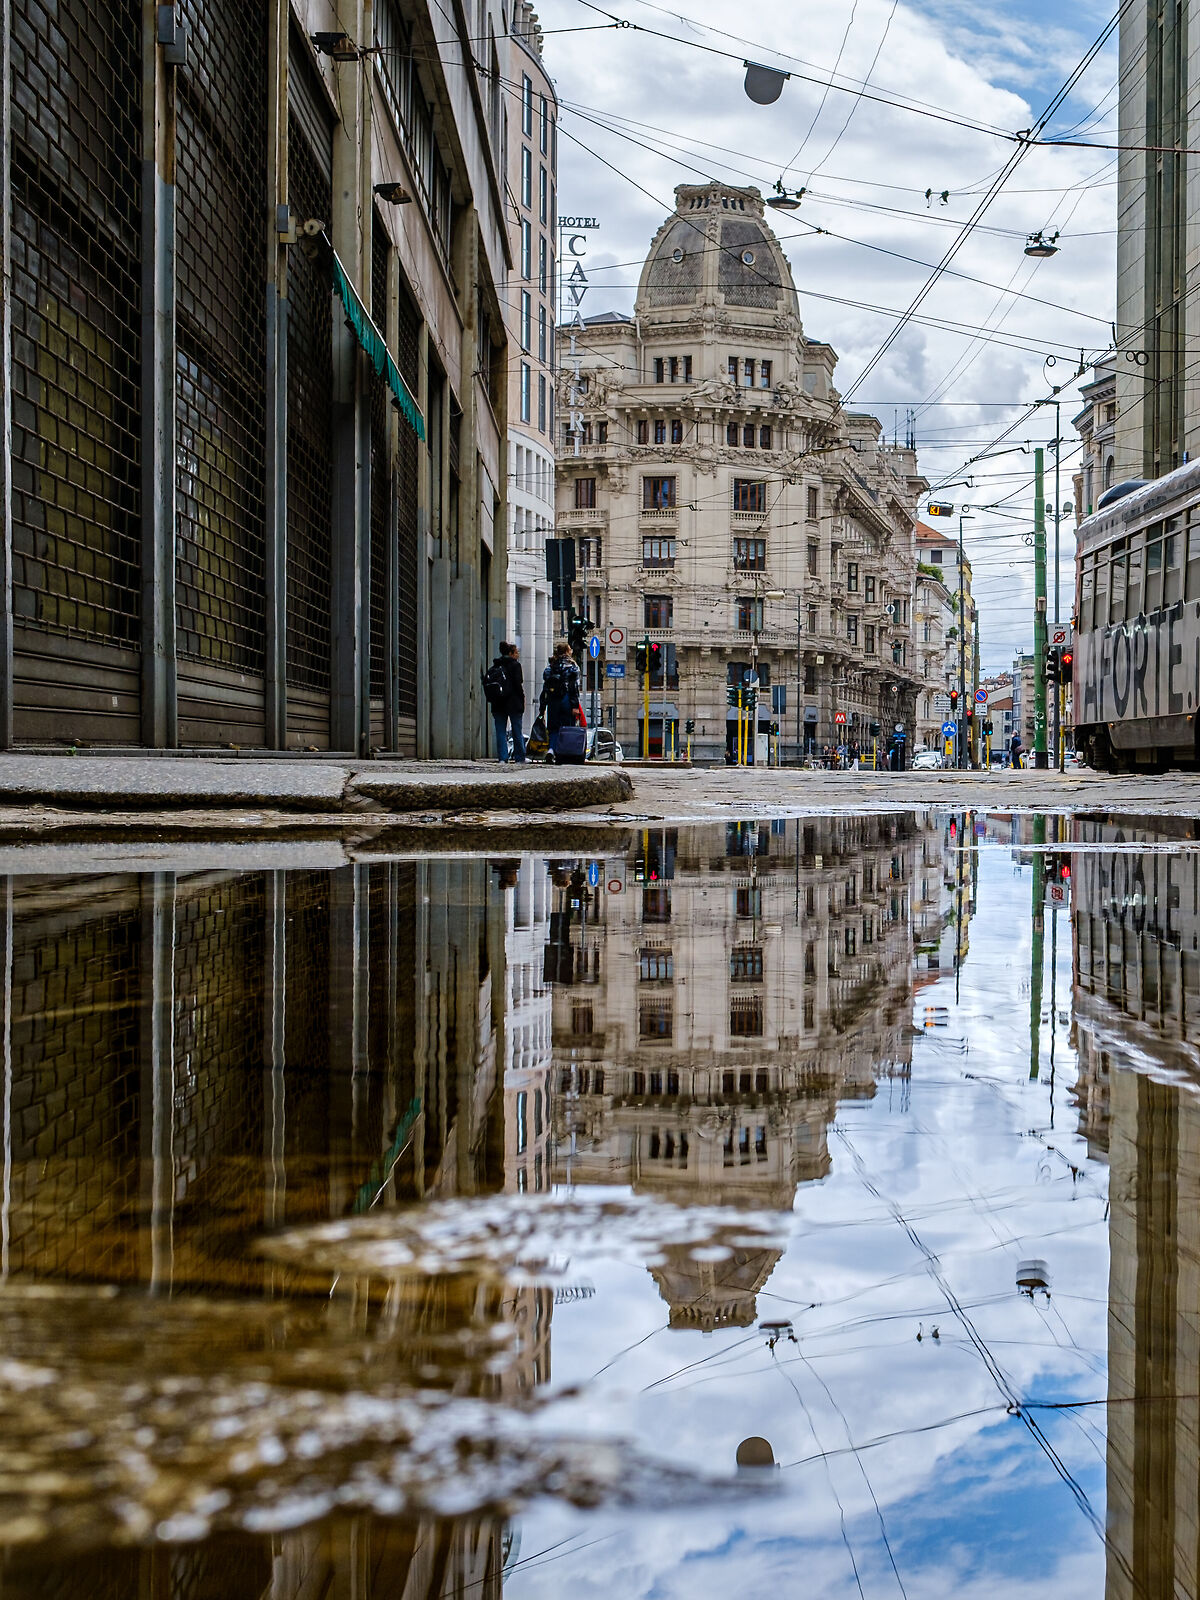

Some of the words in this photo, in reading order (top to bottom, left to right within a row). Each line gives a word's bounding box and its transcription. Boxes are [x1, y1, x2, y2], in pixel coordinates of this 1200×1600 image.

[558, 216, 600, 228] HOTEL
[568, 235, 589, 457] CAVALIERI
[835, 714, 846, 722] M
